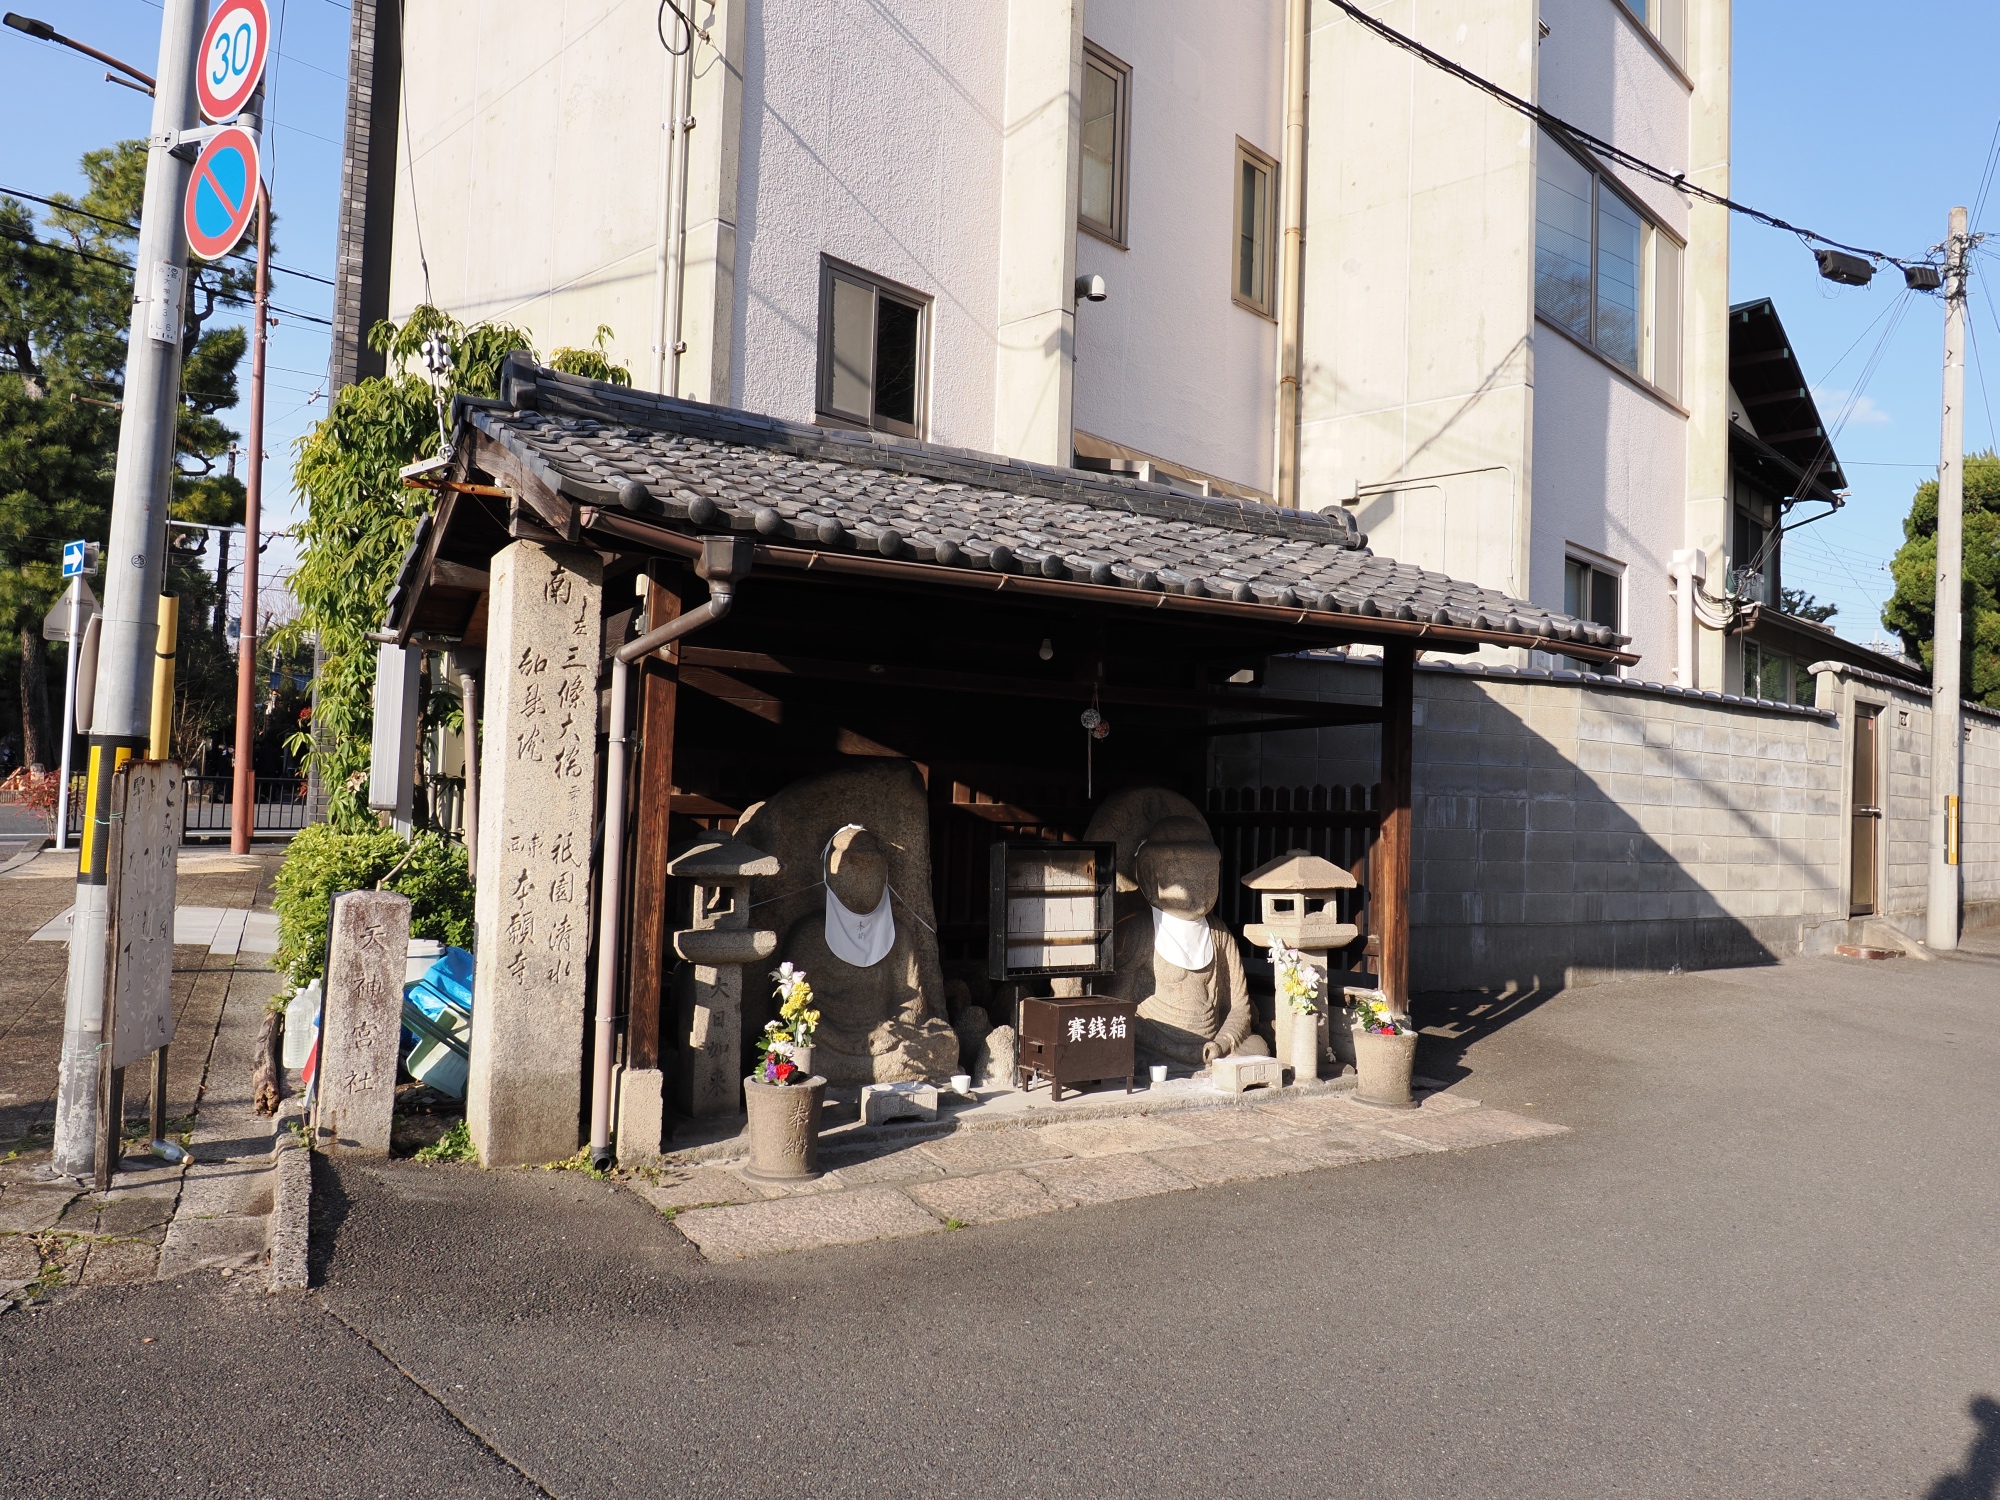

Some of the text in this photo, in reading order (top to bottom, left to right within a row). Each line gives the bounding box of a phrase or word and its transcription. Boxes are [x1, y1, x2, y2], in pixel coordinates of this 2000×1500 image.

[213, 23, 251, 85] 30
[544, 563, 572, 604] 南
[1067, 1015, 1127, 1042] 賽銭箱
